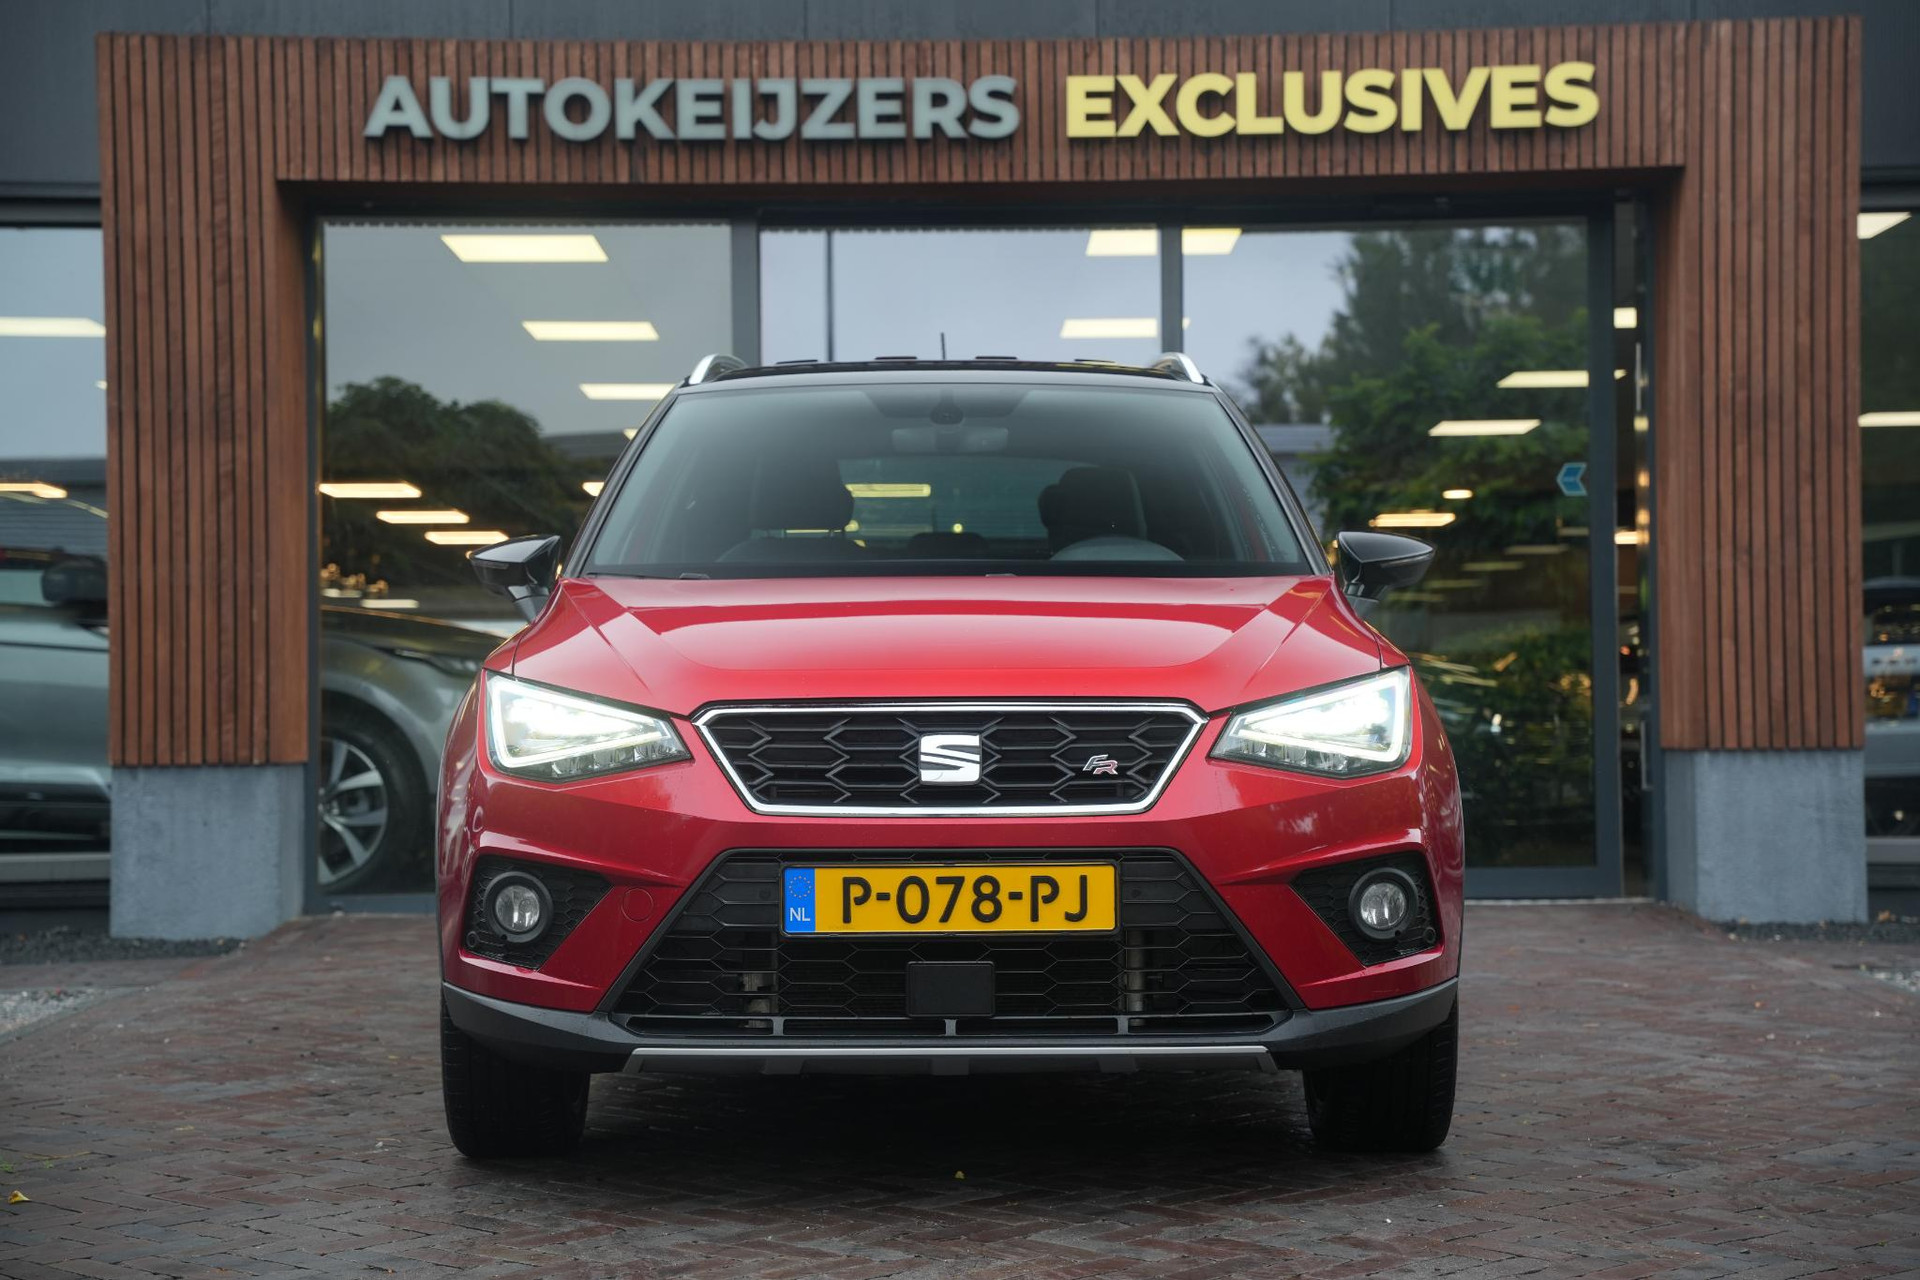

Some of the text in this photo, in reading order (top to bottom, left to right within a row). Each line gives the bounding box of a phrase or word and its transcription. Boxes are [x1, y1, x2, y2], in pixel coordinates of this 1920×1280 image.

[362, 61, 1600, 142] AUTOKEIJZERS EXCLUSIVES
[1082, 754, 1118, 775] FR
[789, 907, 811, 922] NL
[842, 874, 1088, 924] P-078-PJ
